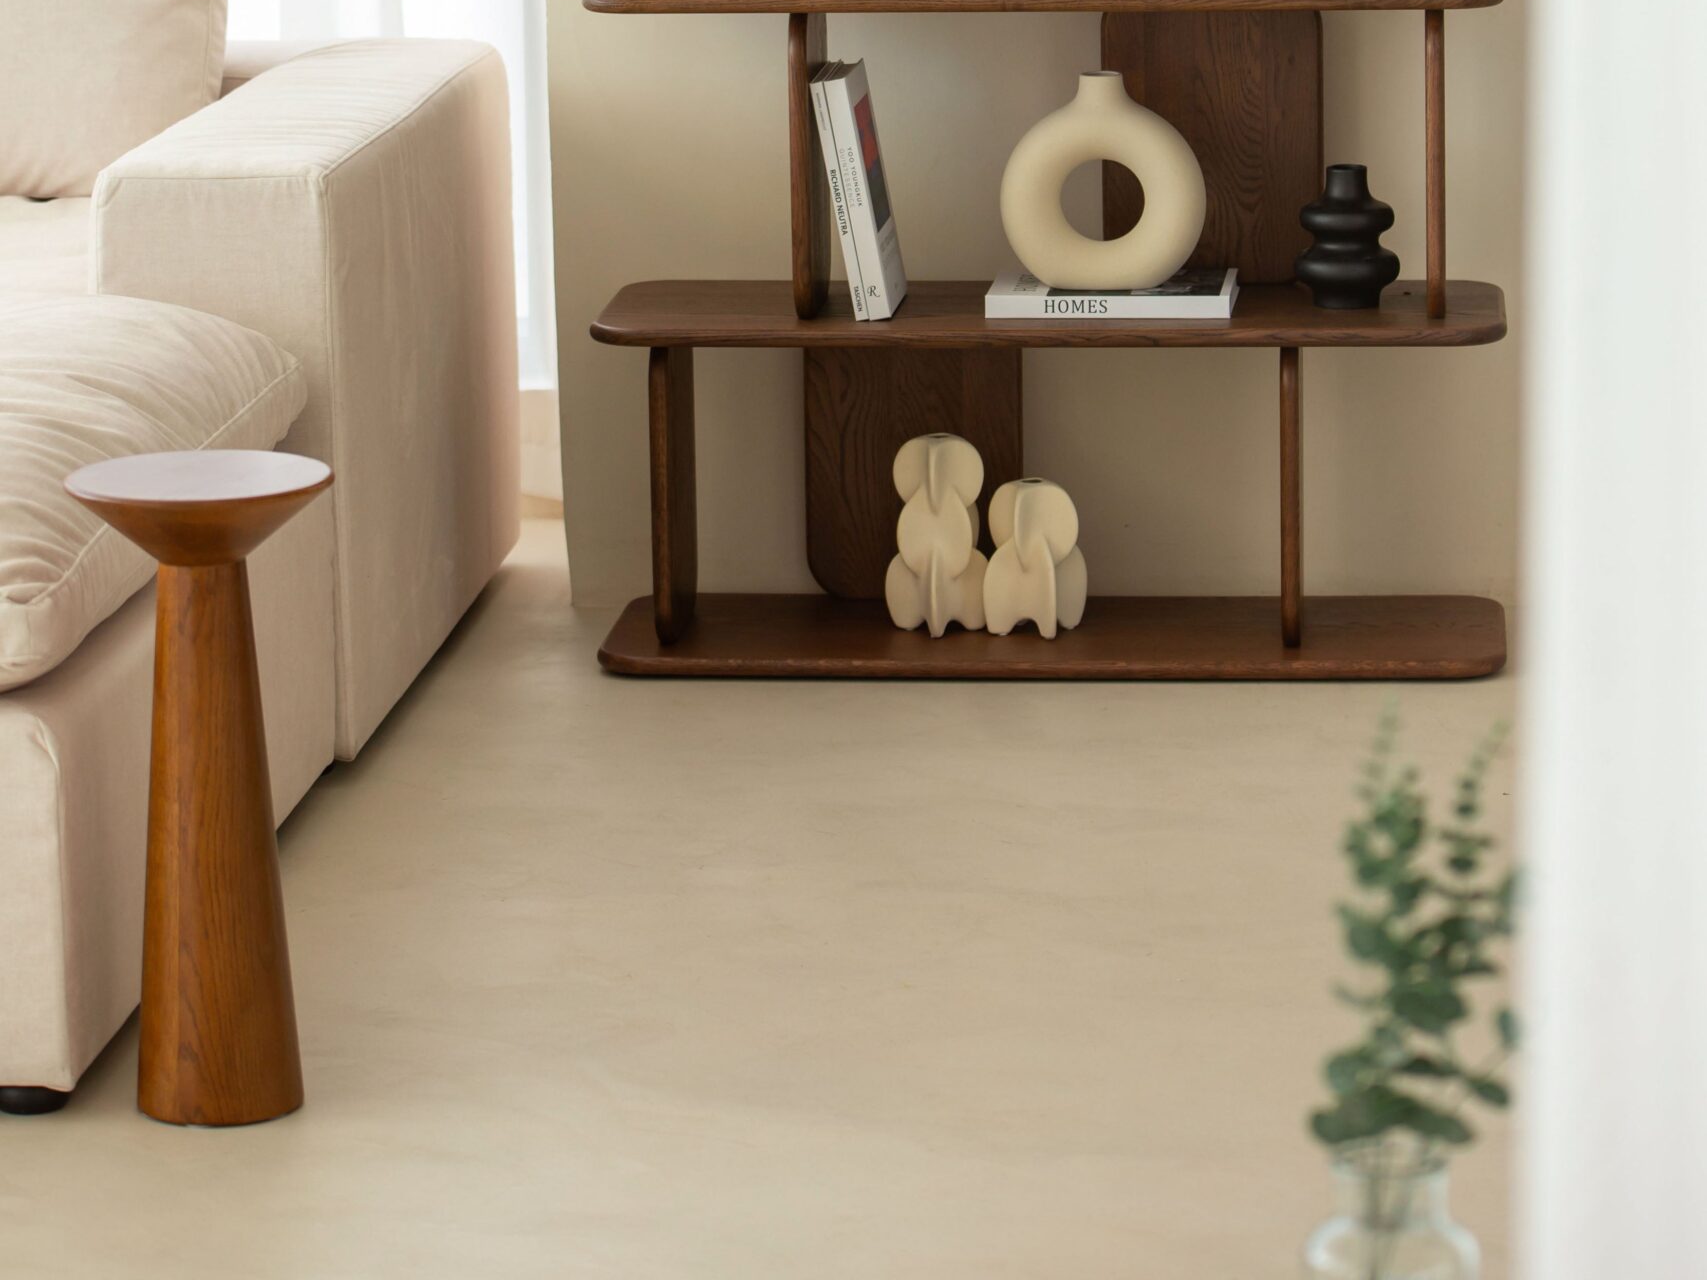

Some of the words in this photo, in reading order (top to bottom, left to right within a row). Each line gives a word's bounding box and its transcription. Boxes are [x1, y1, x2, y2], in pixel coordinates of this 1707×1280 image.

[830, 169, 842, 204] RICHARD
[837, 204, 848, 236] NEUTRA
[839, 148, 855, 208] QUINTESSENCE
[847, 146, 855, 163] YOO
[852, 165, 863, 207] YOUNGKUK
[853, 286, 862, 312] TASCHEN
[1044, 299, 1108, 313] HOMES
